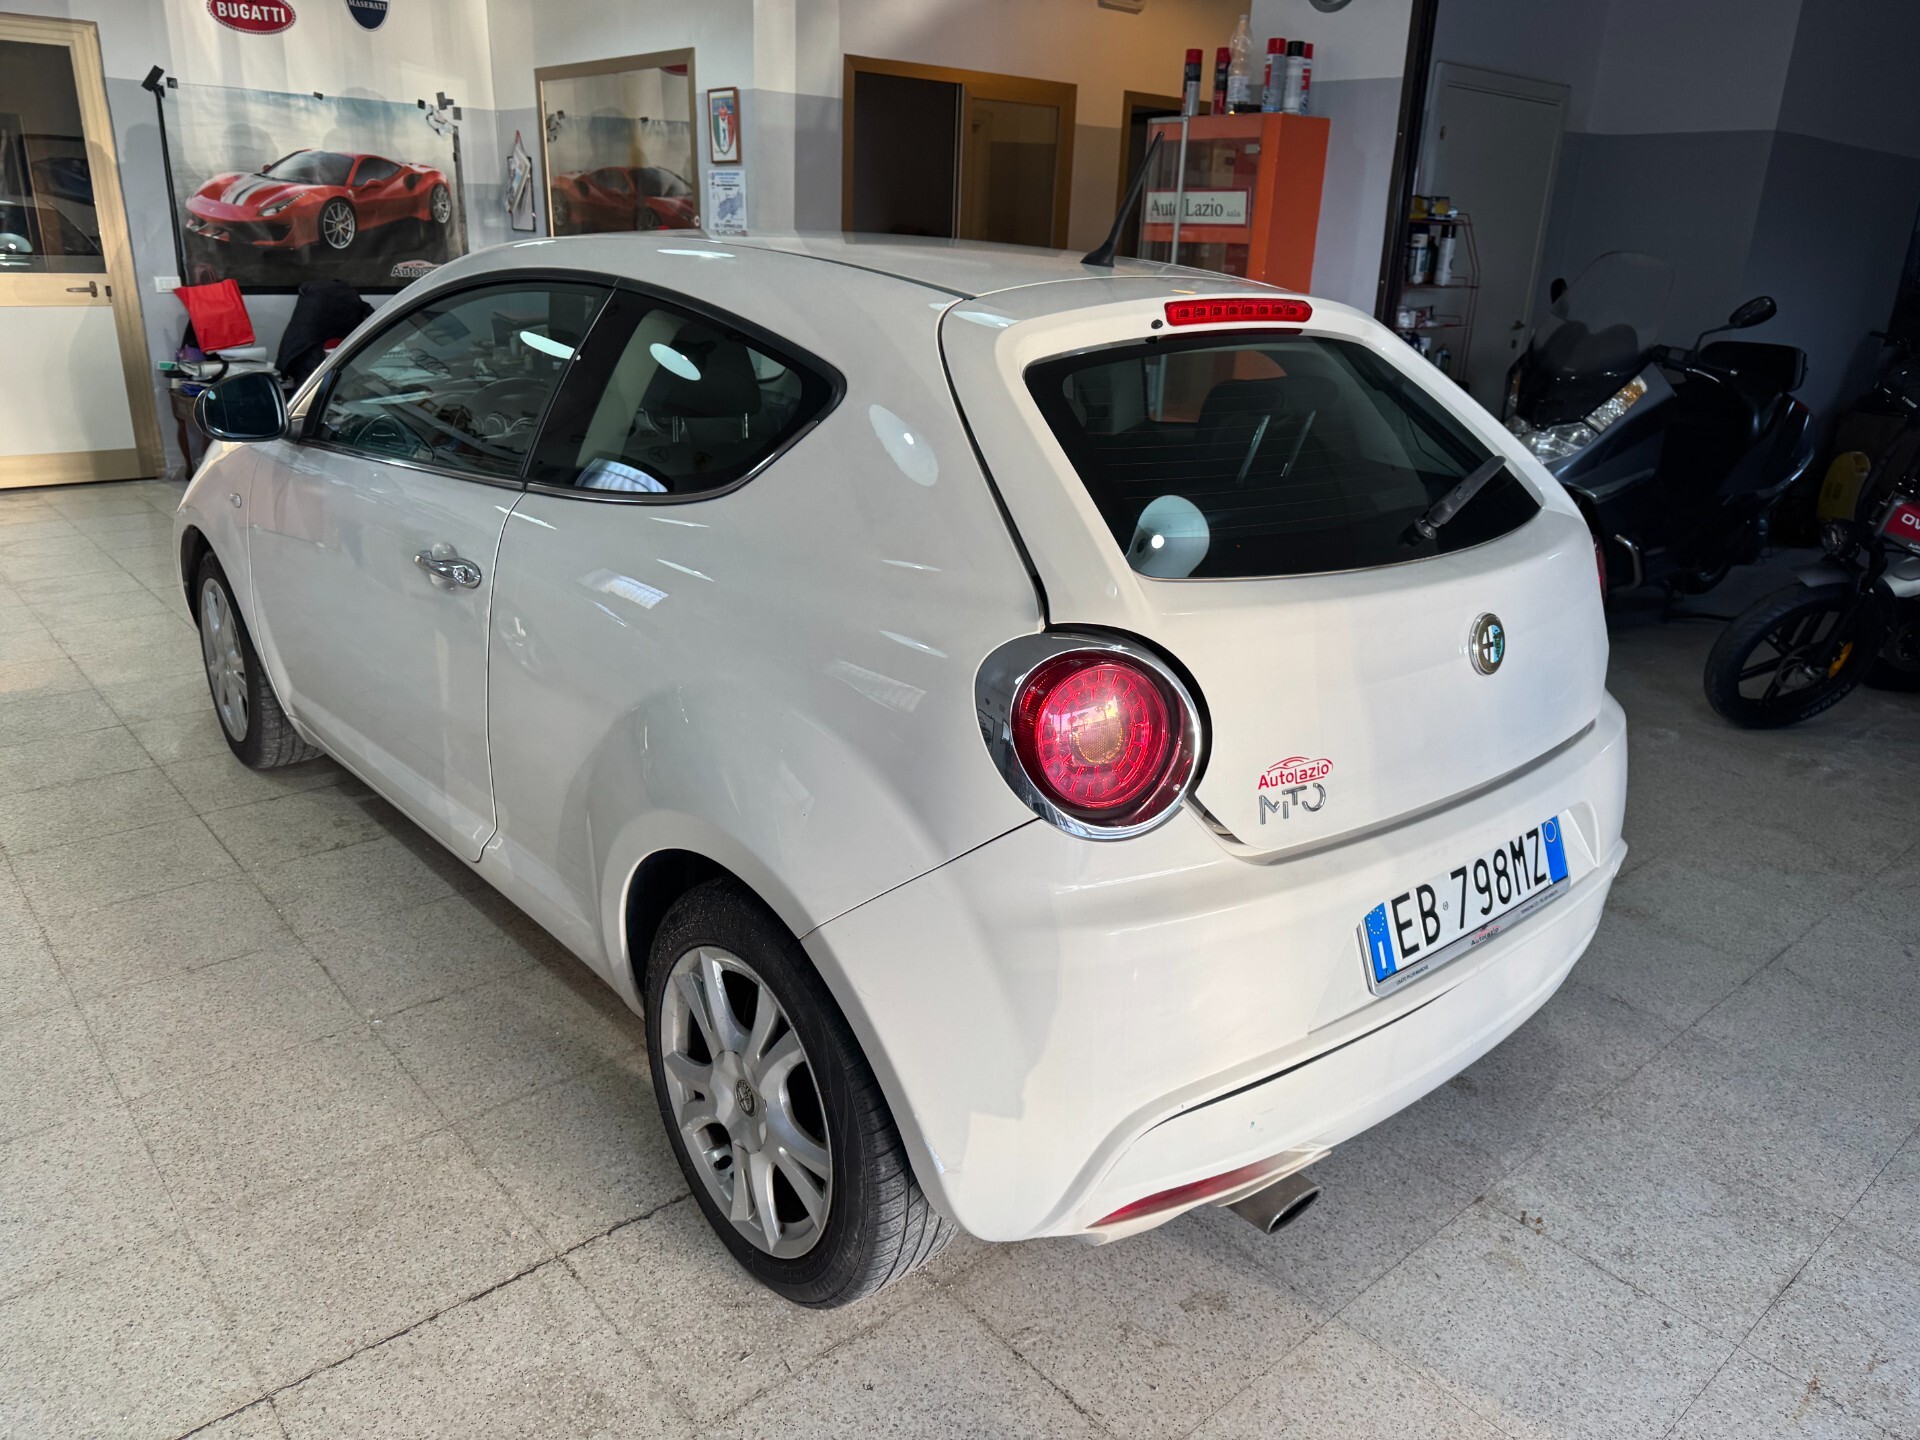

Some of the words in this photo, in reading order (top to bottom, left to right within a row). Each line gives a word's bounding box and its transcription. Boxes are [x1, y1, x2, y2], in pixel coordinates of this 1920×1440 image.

[216, 1, 286, 23] BUGATTI
[348, 0, 387, 11] MASERATI
[1184, 197, 1224, 217] Lazio
[1391, 884, 1441, 959] EB
[1449, 827, 1547, 930] 798MZ
